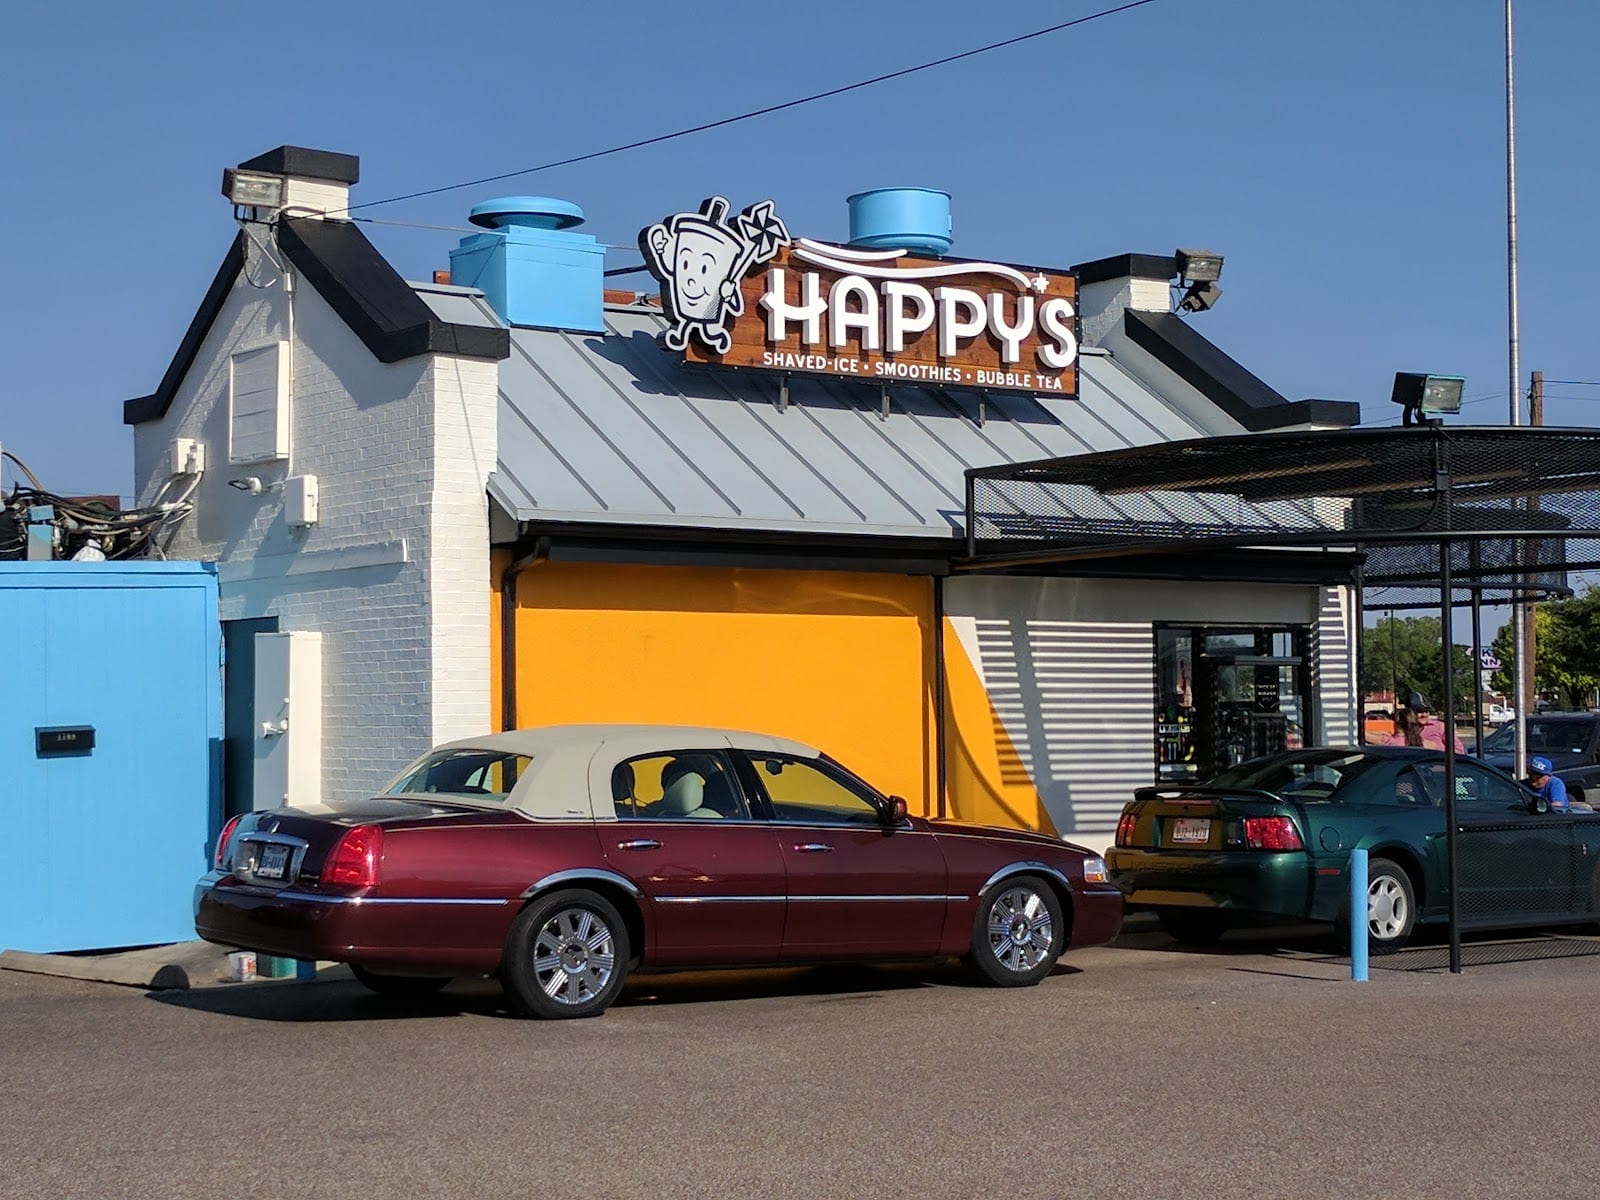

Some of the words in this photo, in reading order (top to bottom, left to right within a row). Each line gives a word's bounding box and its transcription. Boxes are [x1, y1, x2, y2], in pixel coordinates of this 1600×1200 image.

[763, 351, 859, 373] SHAVED-ICE
[875, 361, 962, 382] SMOOTHIES
[976, 369, 1032, 388] BUBBLE
[1036, 374, 1062, 390] TEA
